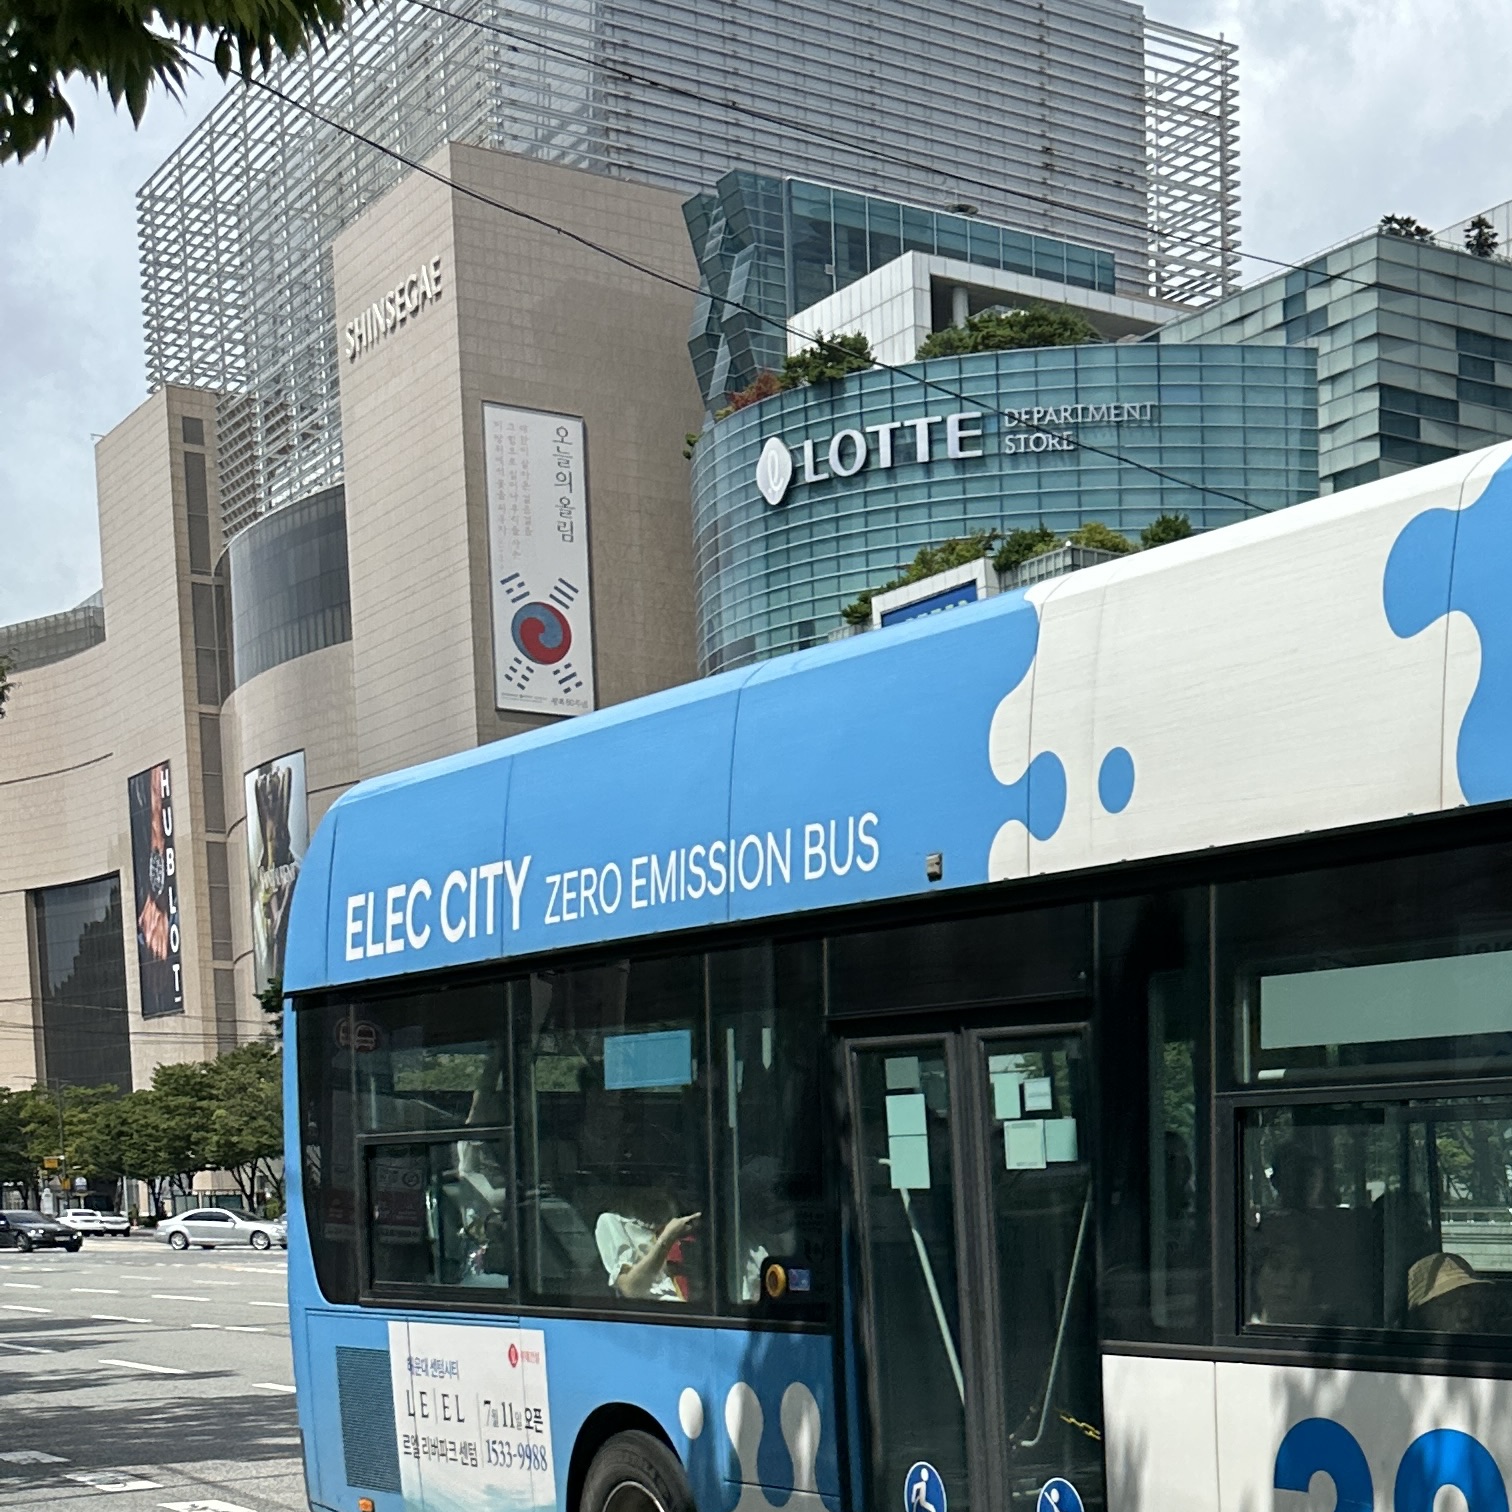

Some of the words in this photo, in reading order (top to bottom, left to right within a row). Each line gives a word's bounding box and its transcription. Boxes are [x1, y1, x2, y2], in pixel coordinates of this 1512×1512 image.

[345, 255, 441, 359] SHINSEGAE
[1004, 401, 1157, 428] DEPARTMENT
[553, 426, 574, 493] 오늘의
[804, 411, 983, 483] LOTTE
[1004, 431, 1075, 455] STORE
[555, 496, 576, 543] 울림
[159, 768, 181, 992] HUBLOT
[344, 878, 432, 962] ELEC
[440, 854, 532, 943] CITY
[544, 861, 622, 925] ZERO
[631, 827, 792, 910] EMISSION
[804, 812, 880, 881] BUS
[524, 1407, 544, 1434] 오픈
[421, 1436, 458, 1463] 리버파크
[459, 1440, 478, 1468] 센텀
[485, 1438, 548, 1472] 1533-9988
